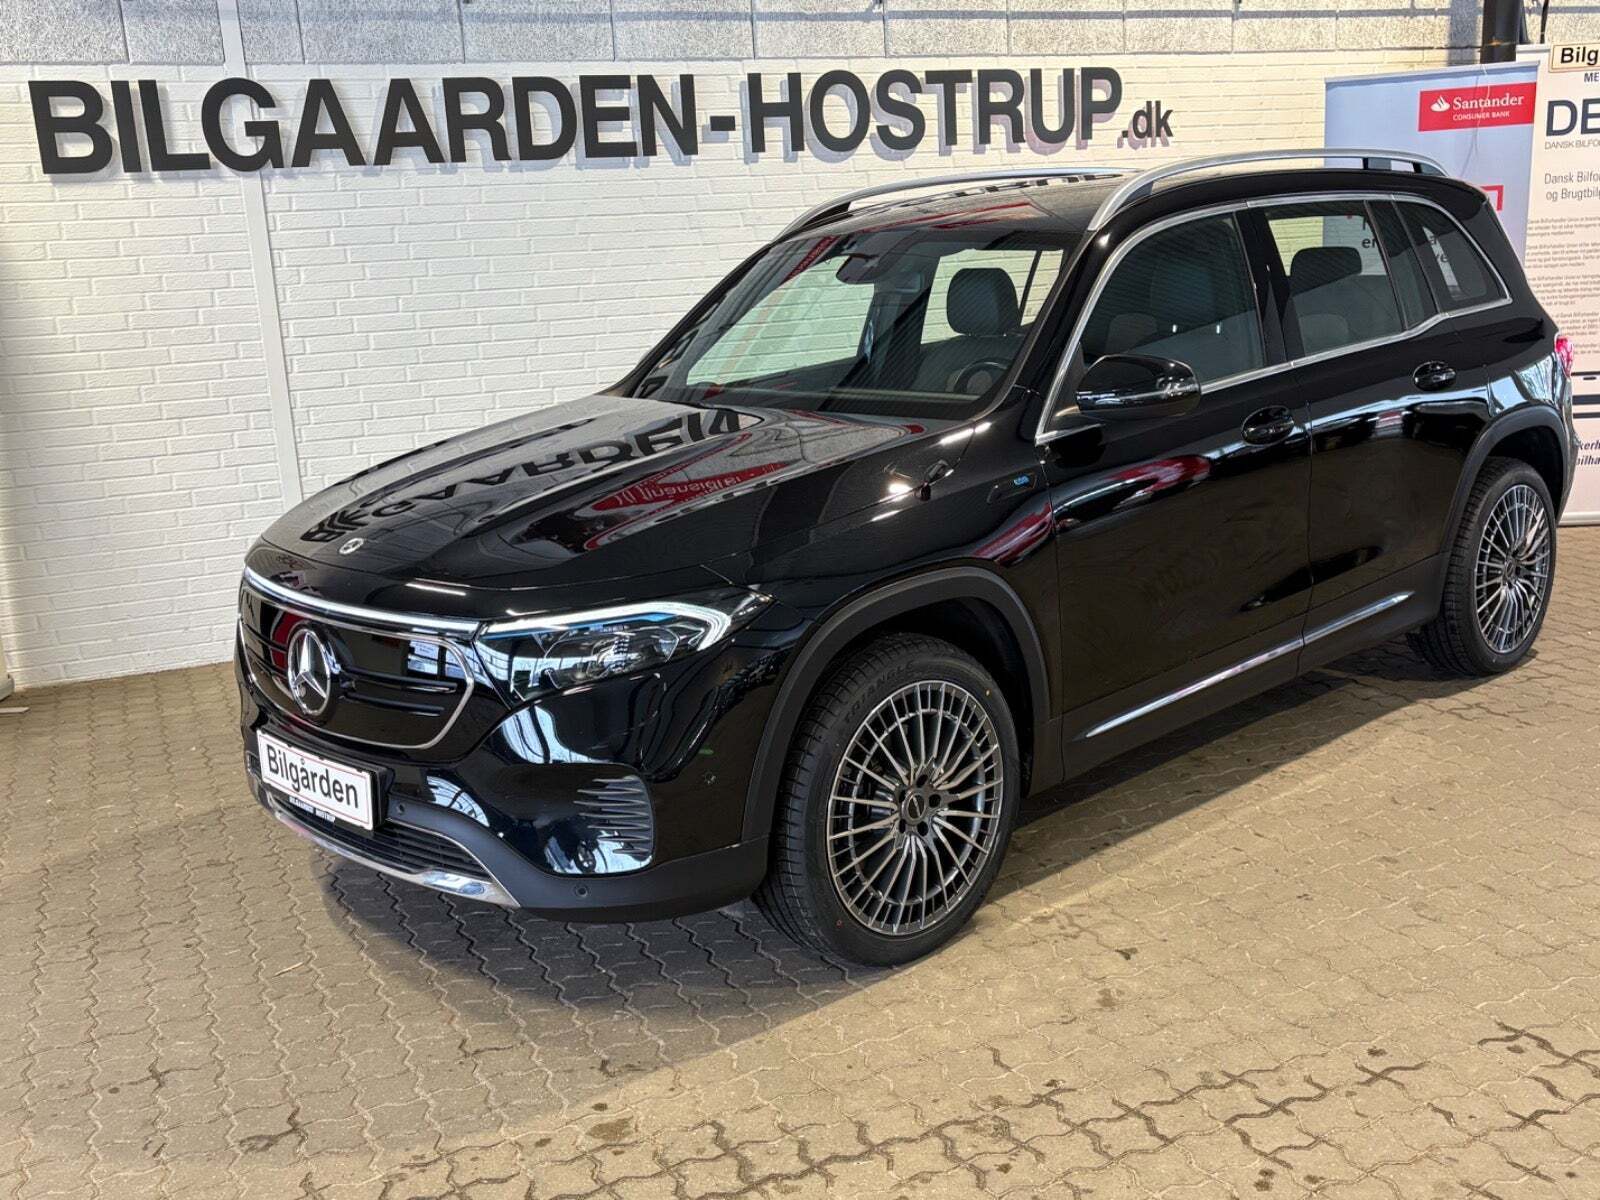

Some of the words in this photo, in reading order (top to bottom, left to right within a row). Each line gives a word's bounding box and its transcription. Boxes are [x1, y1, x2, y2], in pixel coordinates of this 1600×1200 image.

[1452, 92, 1525, 110] Santander
[1452, 113, 1490, 121] CONSUMER
[1491, 110, 1510, 118] BANK
[1544, 171, 1574, 185] Dansk
[1546, 191, 1558, 202] og
[266, 744, 358, 809] Bilgården
